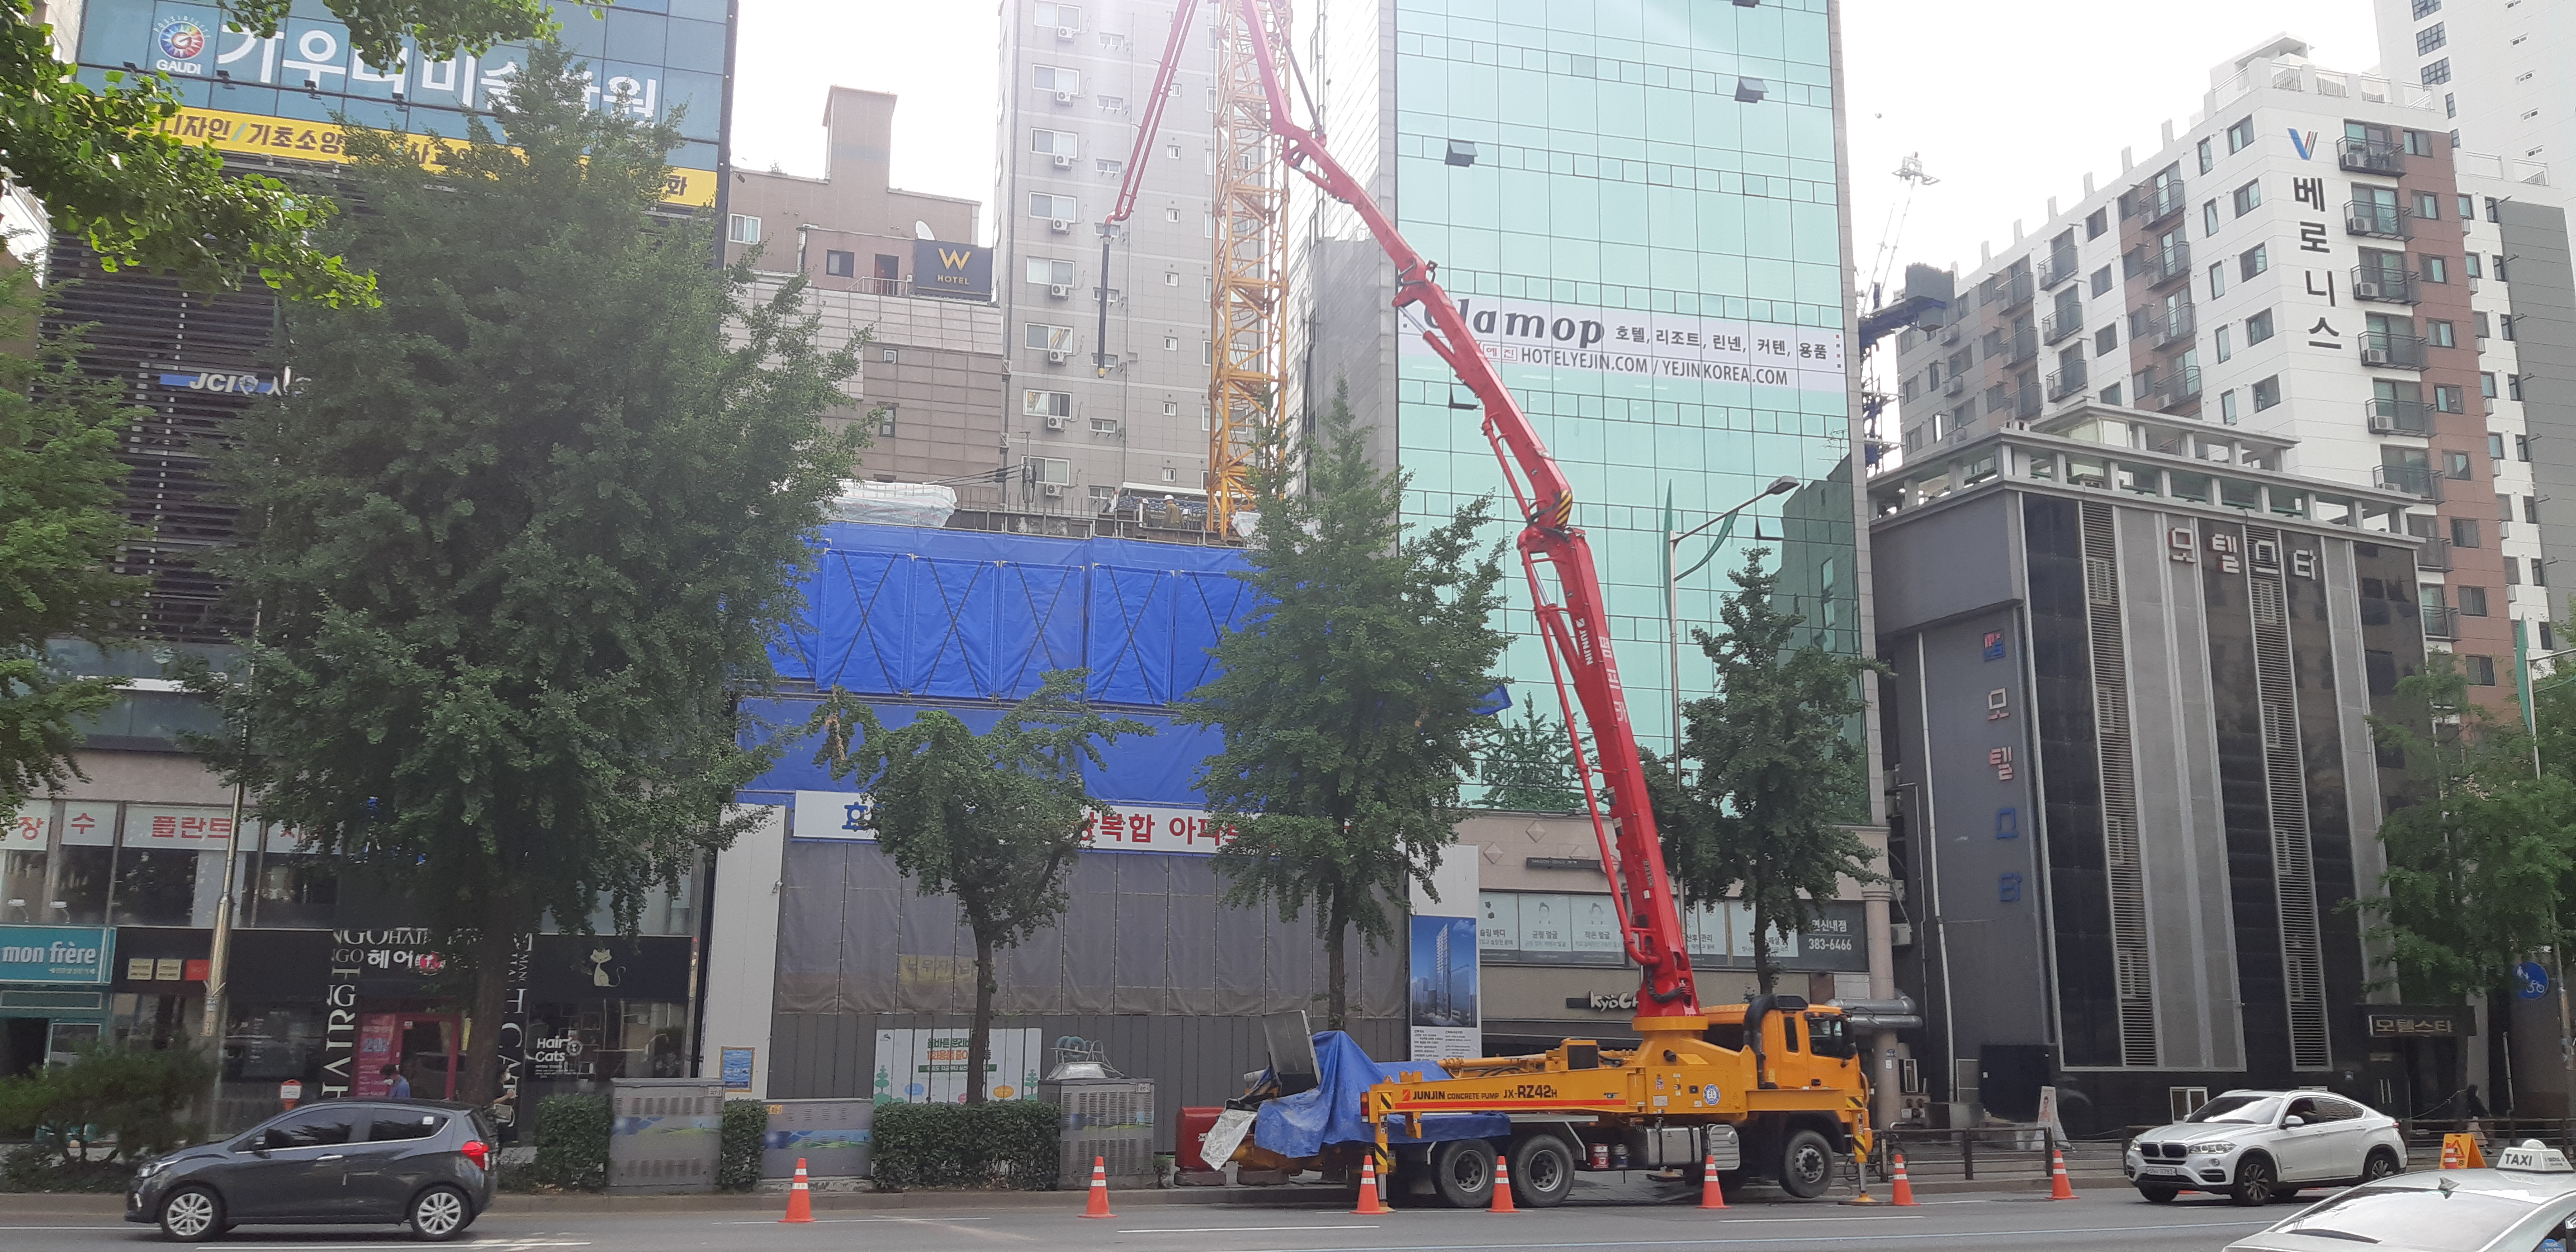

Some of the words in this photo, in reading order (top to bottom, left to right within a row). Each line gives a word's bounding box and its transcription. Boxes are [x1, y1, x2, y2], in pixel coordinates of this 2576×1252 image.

[156, 59, 202, 75] GAUDI
[938, 248, 972, 271] W
[2293, 176, 2342, 350] 베로니스
[937, 274, 970, 286] HOTEL
[1798, 342, 1828, 360] 용품
[1521, 347, 1648, 374] HOTELYEJIN.COM
[1662, 359, 1788, 386] YEJINKOREA.COM
[190, 373, 237, 393] JCI
[2168, 527, 2317, 581] 모텔스타
[1579, 630, 1593, 666] JUNJIN
[1987, 687, 2023, 902] 모텔스타
[2, 946, 45, 963] mon
[49, 941, 97, 964] frère
[1808, 938, 1852, 951] 383-6466
[2376, 1018, 2453, 1033] 모텔스타
[537, 1035, 572, 1049] Hair
[531, 1051, 566, 1062] Cats
[1413, 1090, 1445, 1100] JUNJIN
[1503, 1084, 1558, 1099] JX-RZ42H
[2505, 1153, 2533, 1166] TAXI
